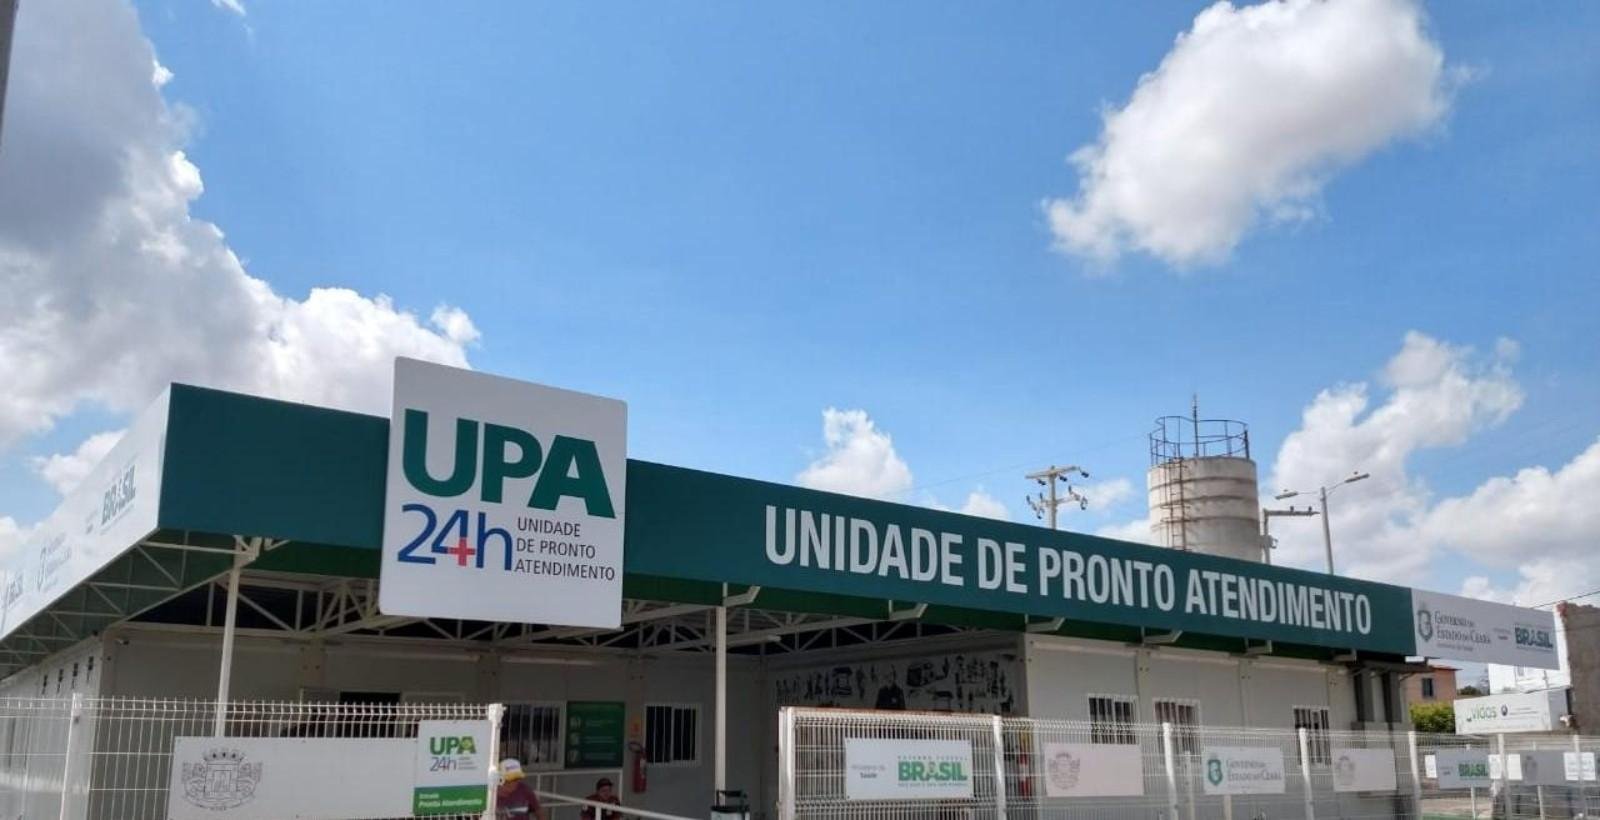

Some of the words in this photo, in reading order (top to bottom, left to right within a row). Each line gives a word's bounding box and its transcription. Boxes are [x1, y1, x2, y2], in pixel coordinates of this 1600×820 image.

[402, 408, 616, 519] UPA
[397, 503, 513, 571] 24h
[517, 516, 581, 537] UNIDADE
[516, 537, 534, 553] DE
[539, 542, 596, 559] PRONTO
[514, 558, 615, 581] ATENDIMENTO
[765, 504, 965, 586] UNIDADE
[977, 537, 1028, 594] DE
[1038, 547, 1175, 612] PRONTO
[1185, 569, 1372, 635] ATENDIMENTO
[1514, 626, 1554, 649] BRASIL
[429, 736, 476, 755] UPA
[429, 757, 457, 772] 24h
[898, 761, 968, 781] BRASIL
